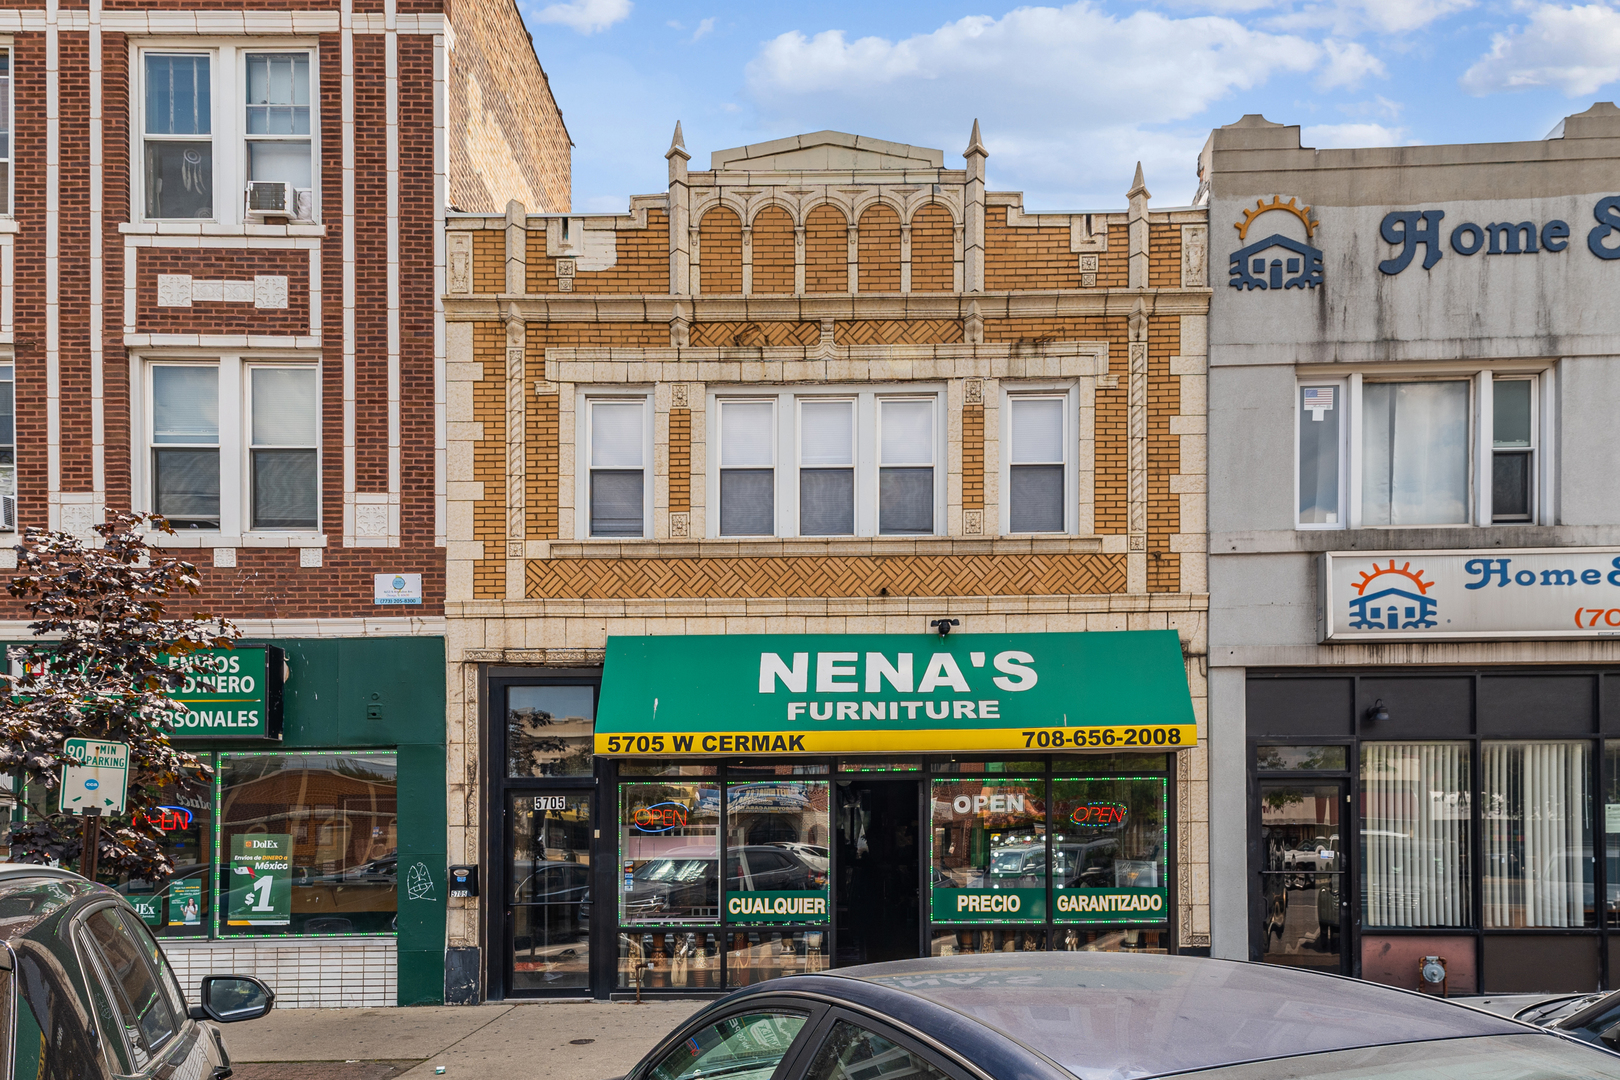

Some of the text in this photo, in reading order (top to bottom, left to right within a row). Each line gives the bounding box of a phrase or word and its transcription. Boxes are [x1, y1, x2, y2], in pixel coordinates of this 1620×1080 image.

[1378, 209, 1571, 276] Home
[758, 650, 1039, 694] NENA'S
[787, 699, 1001, 721] FURNITURE
[607, 734, 806, 753] 5705 W CERMAK
[1022, 728, 1182, 748] 708-656-2008
[100, 745, 117, 755] MIN
[86, 755, 125, 767] PARKING
[535, 796, 565, 809] 5705
[953, 792, 1026, 814] OPEN
[634, 808, 688, 827] OPEN
[1073, 805, 1125, 823] OPEN
[252, 840, 279, 849] DolEx
[254, 861, 288, 870] México
[135, 903, 156, 915] lEx
[728, 896, 826, 916] CUALQUIER
[957, 894, 1021, 913] PRECIO
[1056, 894, 1163, 912] GARANTIZADO
